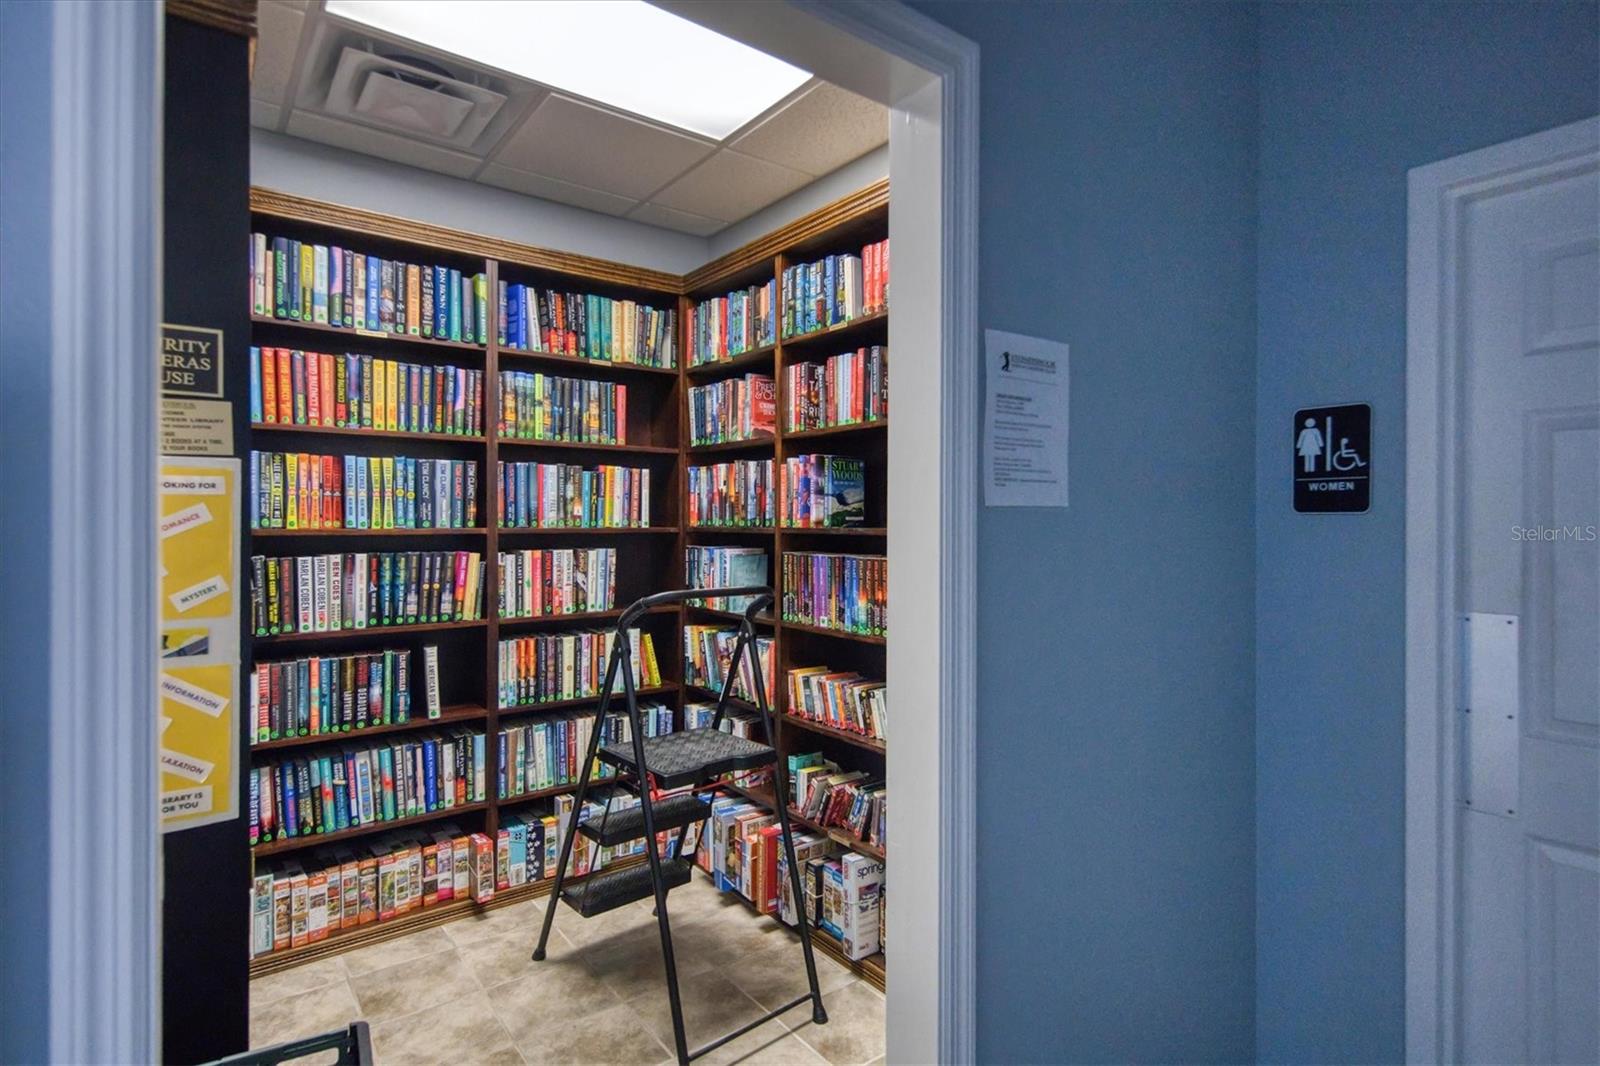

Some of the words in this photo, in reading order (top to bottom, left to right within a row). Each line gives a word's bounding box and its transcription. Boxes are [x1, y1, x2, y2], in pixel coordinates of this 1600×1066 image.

[162, 338, 210, 354] RITY
[161, 354, 211, 370] ERAS
[832, 460, 863, 470] STUAR
[833, 470, 864, 480] WOODS
[1308, 482, 1355, 492] WOMEN
[162, 513, 200, 531] OMANCE
[300, 560, 309, 587] HARLAN
[316, 559, 325, 585] HARLAN
[180, 584, 218, 603] MYSTERY
[301, 589, 309, 611] COBEN
[162, 682, 218, 709] INFORMATION
[358, 688, 367, 720] DEADLOCK
[162, 757, 204, 774] LAXATION
[162, 794, 191, 804] BRARY
[162, 805, 176, 813] OR
[178, 802, 198, 811] YOU
[857, 864, 884, 878] spring
